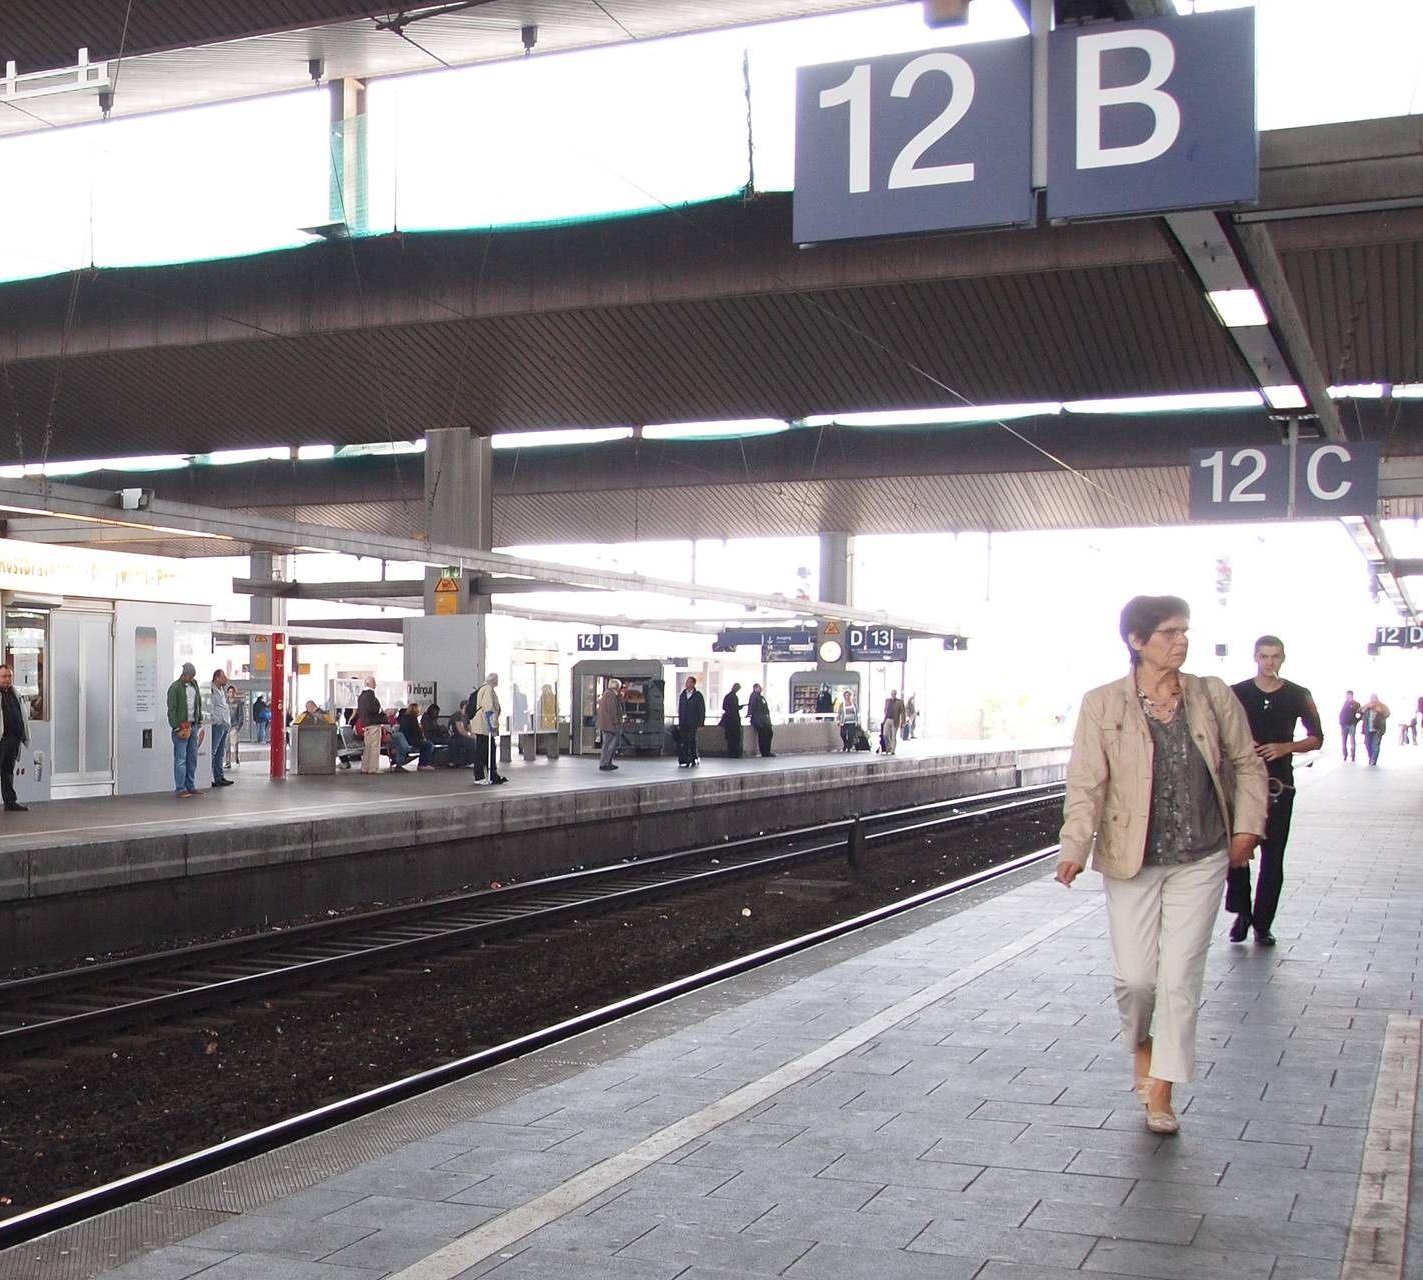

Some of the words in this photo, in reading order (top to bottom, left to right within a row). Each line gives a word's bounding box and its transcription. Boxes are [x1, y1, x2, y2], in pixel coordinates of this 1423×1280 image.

[819, 51, 975, 194] 12
[1076, 28, 1181, 171] B
[1200, 448, 1267, 502] 12
[1306, 445, 1352, 500] C
[578, 634, 595, 649] 14
[602, 634, 614, 648] D
[850, 630, 863, 646] D
[871, 630, 890, 646] 13
[1377, 627, 1399, 643] 12
